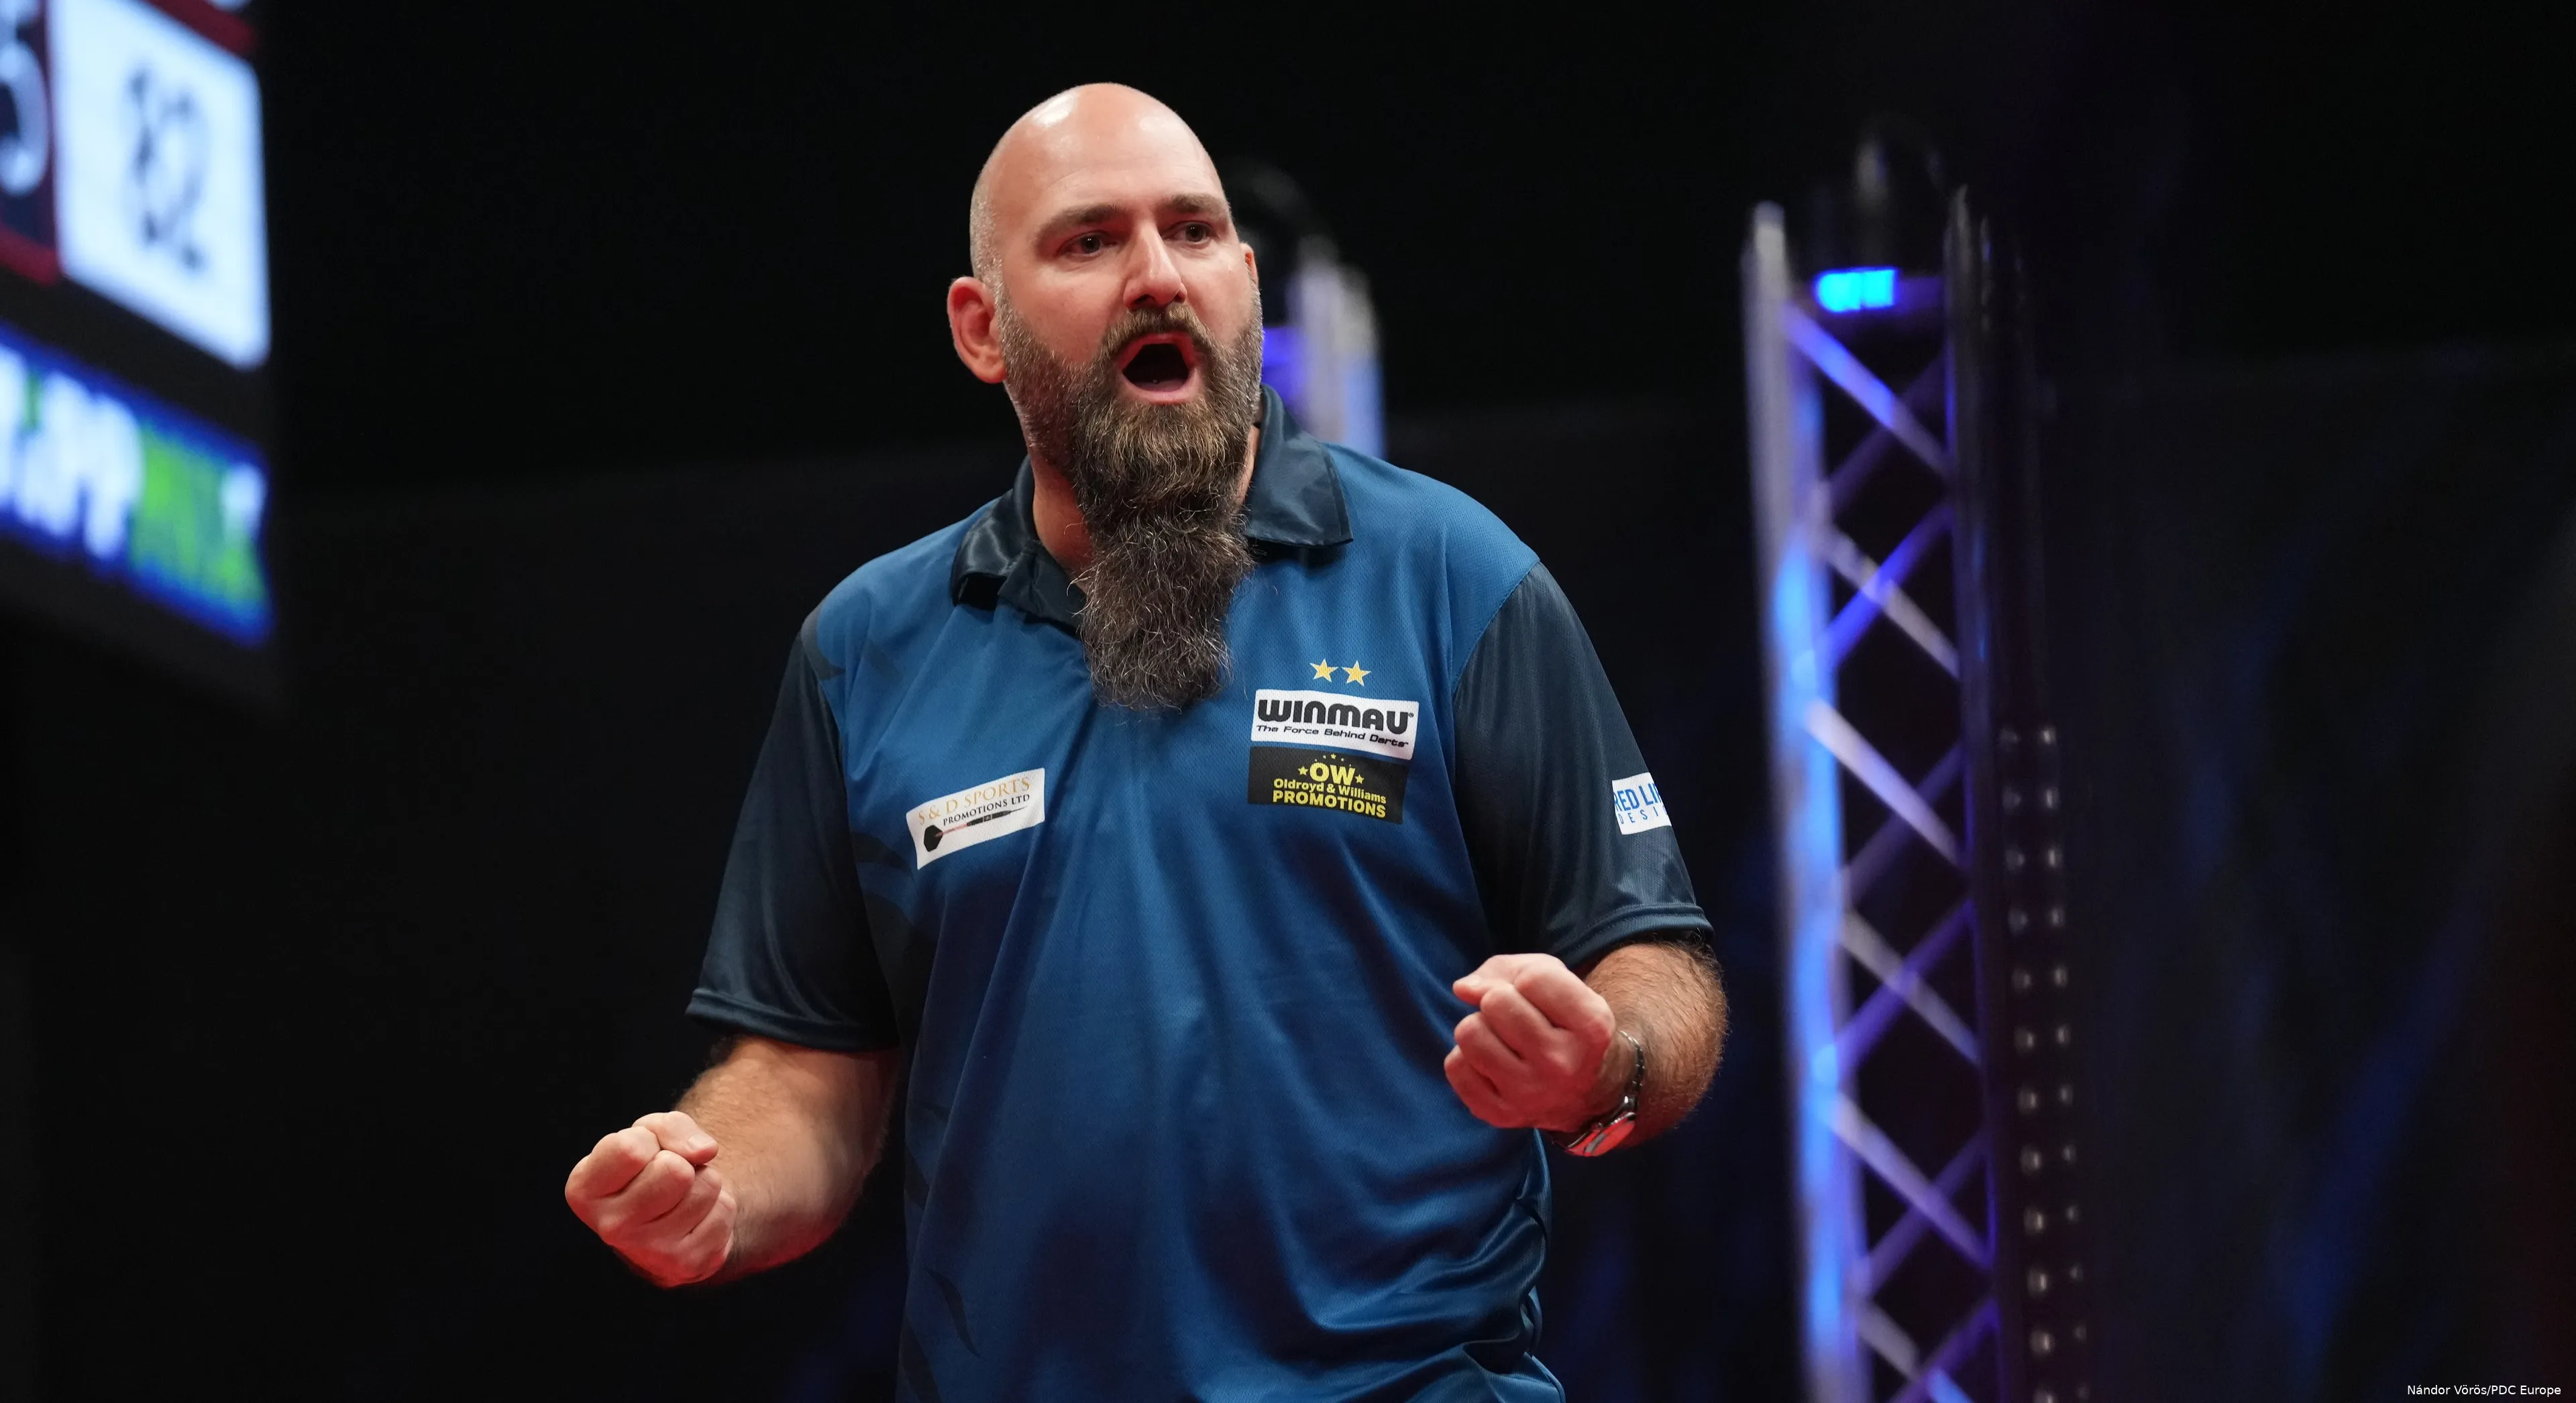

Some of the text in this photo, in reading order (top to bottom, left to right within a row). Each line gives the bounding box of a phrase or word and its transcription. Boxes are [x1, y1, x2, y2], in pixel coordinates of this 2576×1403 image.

[1283, 726, 1319, 735] Force
[1324, 728, 1365, 740] Behind
[1309, 762, 1355, 786] OW
[918, 777, 1031, 825] S & D SPORTS
[1273, 790, 1386, 818] PROMOTIONS
[1274, 778, 1387, 804] Oldroyd & Williams
[943, 793, 1030, 826] PROMOTIONS LTD
[1618, 805, 1668, 824] DESI
